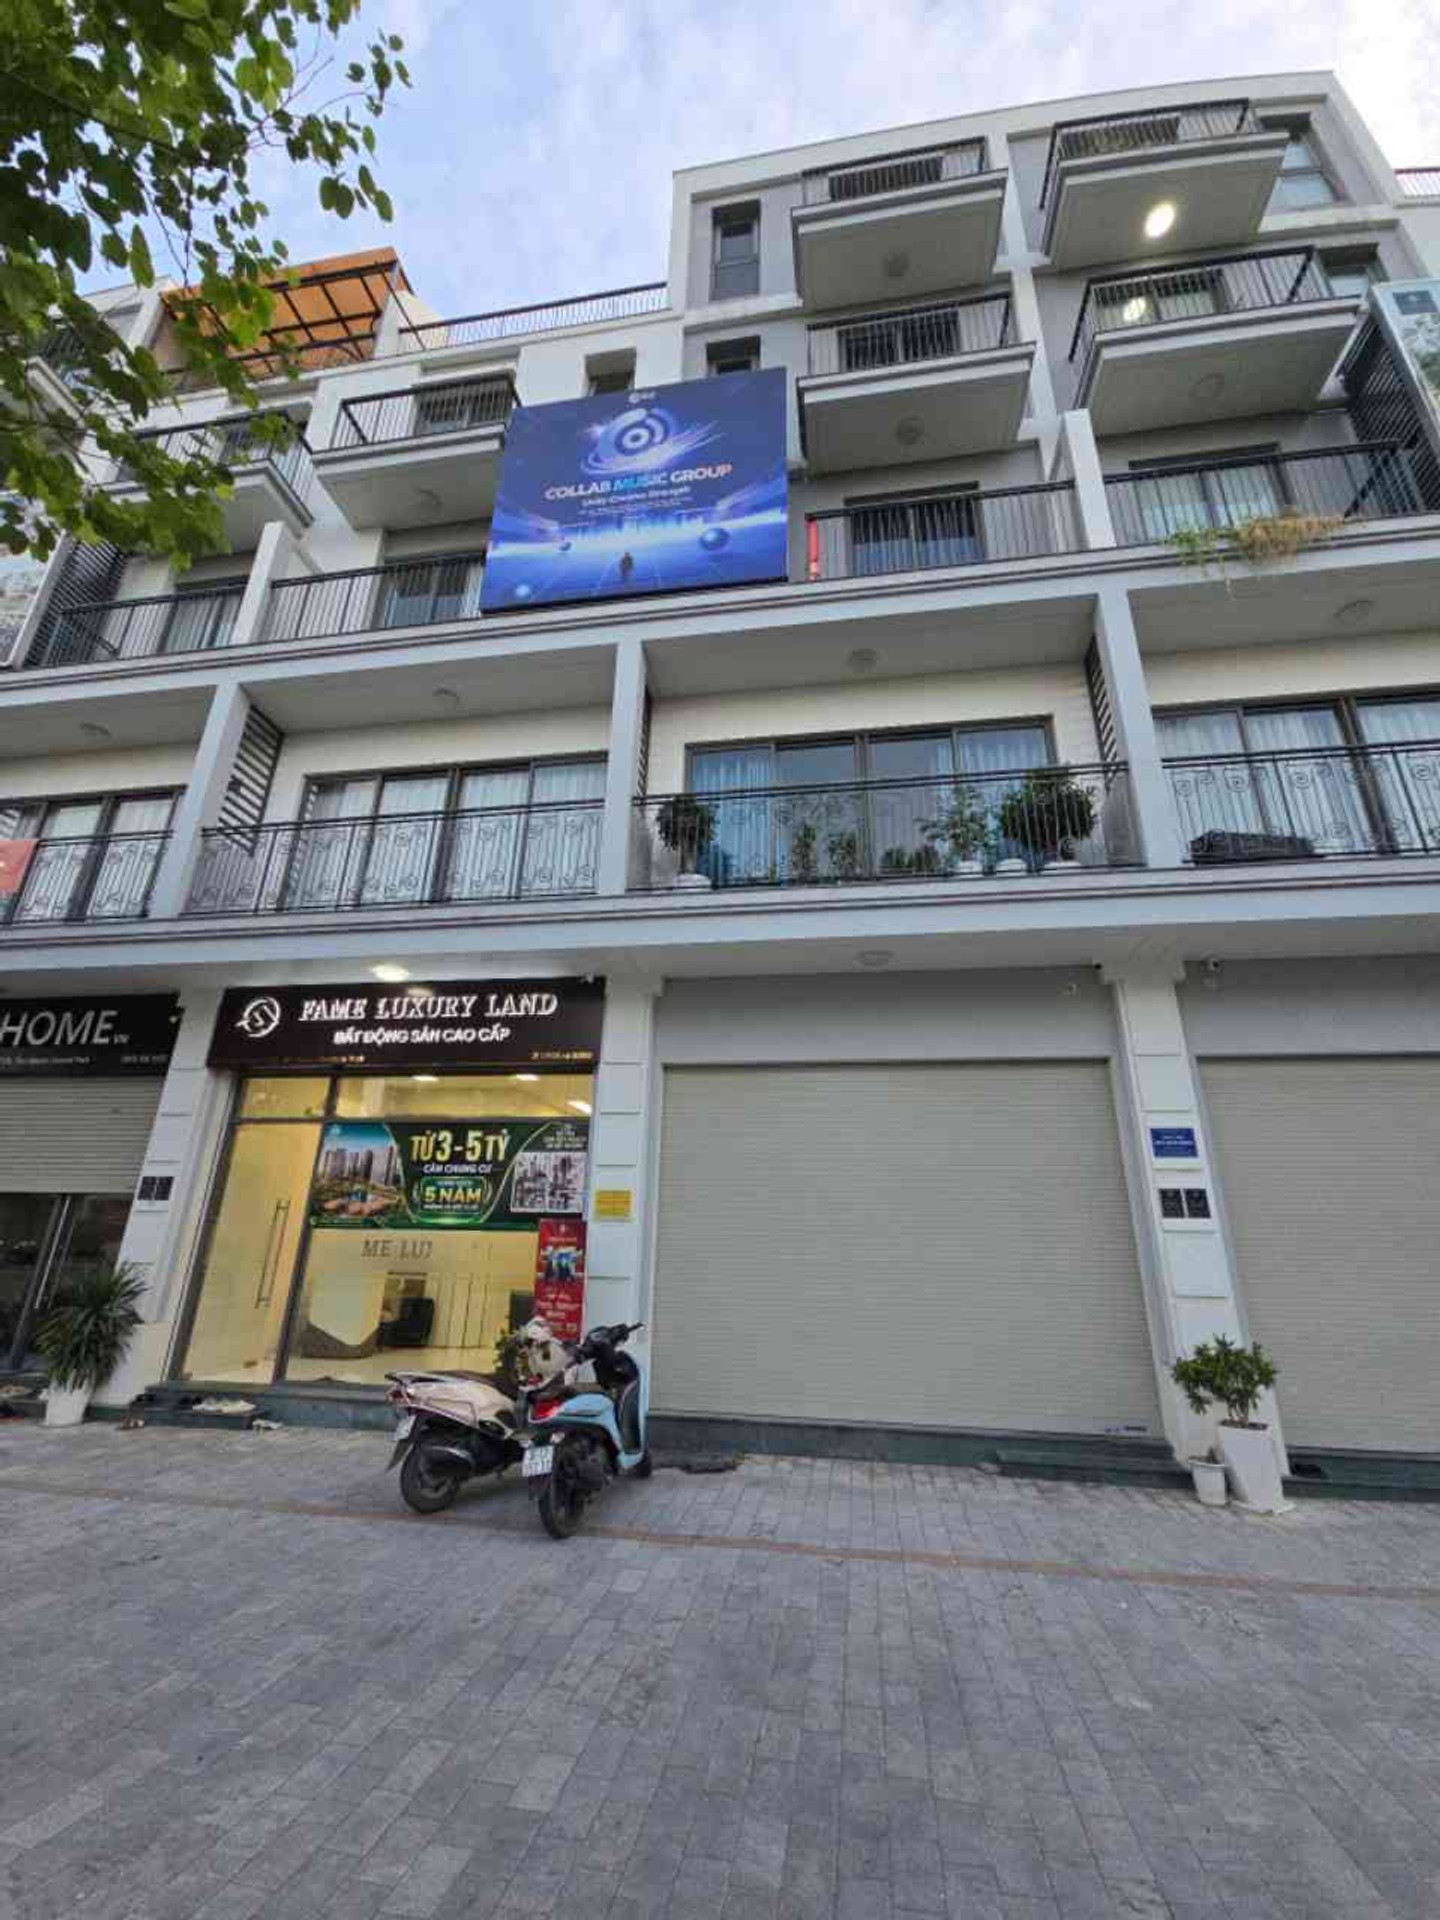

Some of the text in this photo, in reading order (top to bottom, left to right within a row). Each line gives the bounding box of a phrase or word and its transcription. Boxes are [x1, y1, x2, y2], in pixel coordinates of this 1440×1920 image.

[544, 480, 611, 500] COLLAB
[613, 472, 667, 491] MUSIC
[670, 463, 733, 483] GROUP
[298, 992, 558, 1021] FAME LUXURY LAND
[442, 1026, 477, 1043] CAO
[425, 1186, 436, 1203] 5
